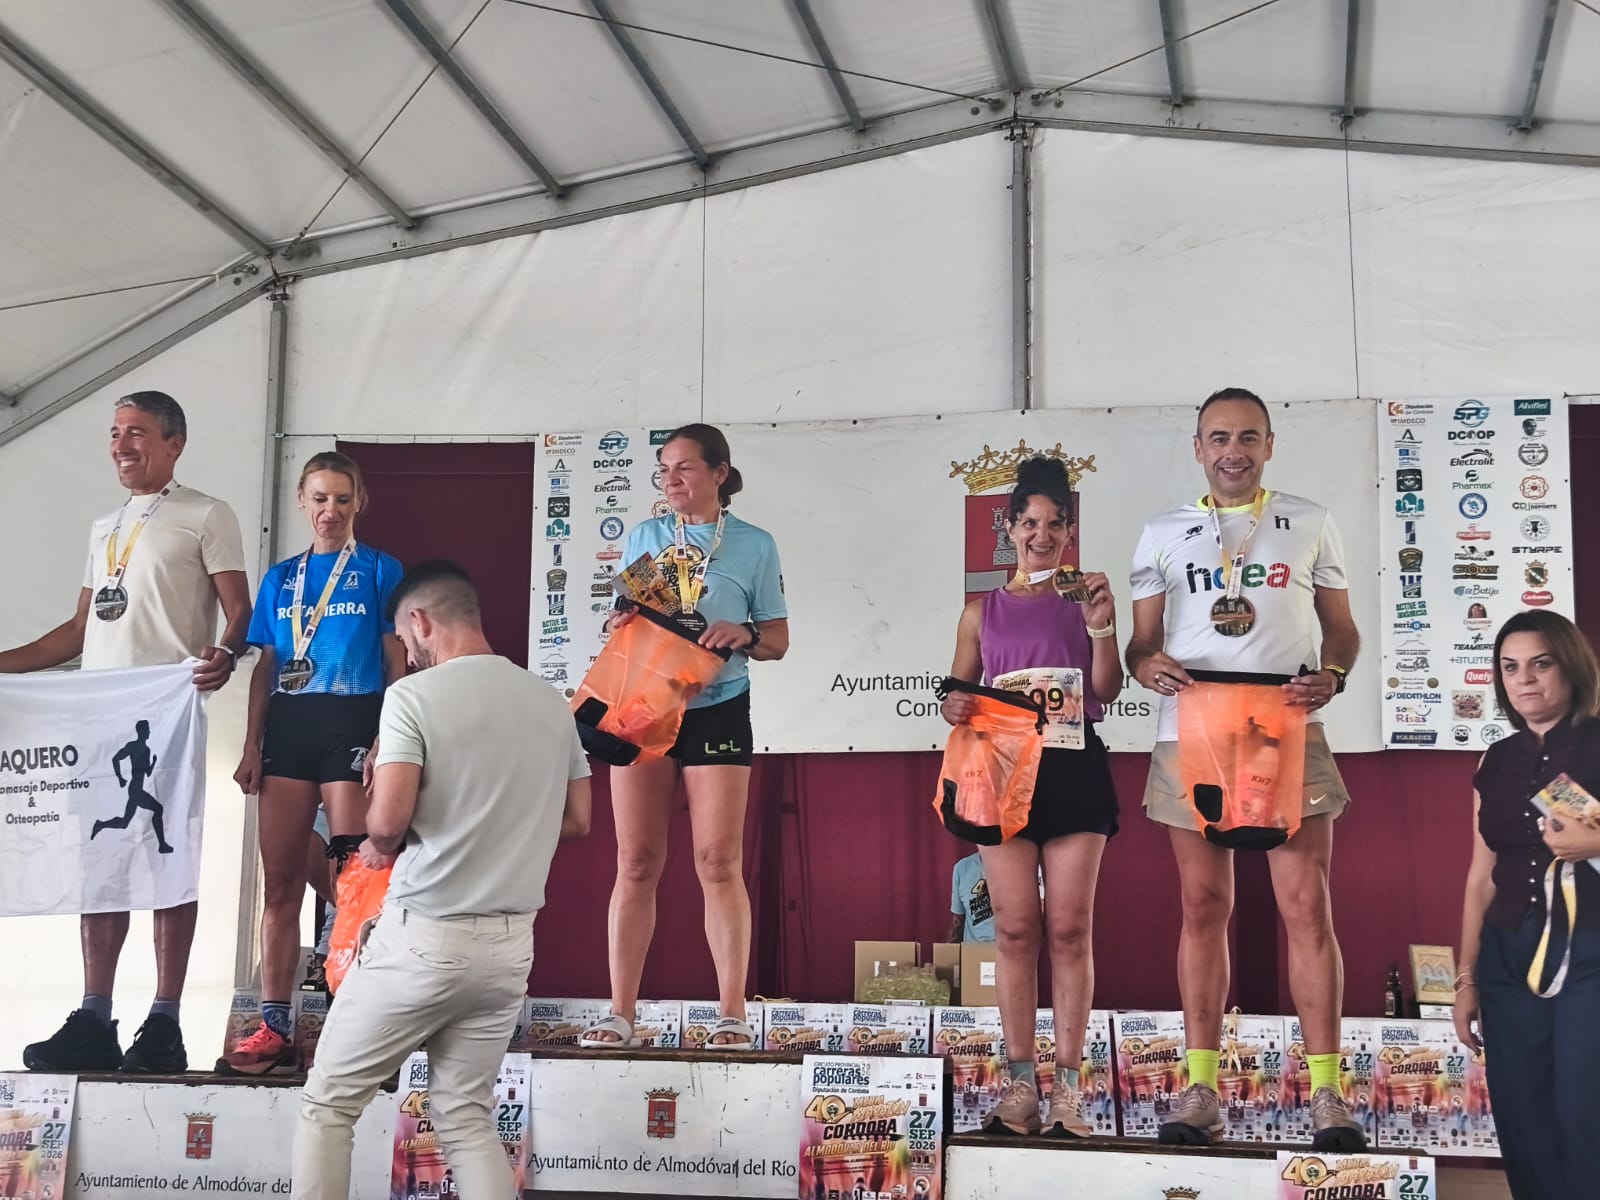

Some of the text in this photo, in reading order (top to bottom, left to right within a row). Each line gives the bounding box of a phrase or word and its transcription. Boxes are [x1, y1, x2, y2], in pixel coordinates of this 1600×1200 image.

[1450, 457, 1494, 467] Electrolit
[594, 483, 632, 493] Electrolit
[831, 671, 950, 697] Ayuntamie
[1102, 697, 1150, 717] ortes
[0, 744, 79, 775] AQUERO
[0, 778, 90, 796] omasaje Deportivo
[6, 811, 60, 826] Osteopatía
[661, 1033, 676, 1044] 27
[828, 1034, 843, 1046] 27
[909, 1038, 925, 1049] 27
[1091, 1042, 1107, 1052] 27
[1263, 1051, 1280, 1062] 27
[1354, 1053, 1372, 1064] 27
[1447, 1055, 1464, 1067] 27
[814, 1066, 861, 1077] carreras
[813, 1073, 869, 1086] populares
[498, 1104, 523, 1121] 27
[909, 1111, 936, 1128] 27
[43, 1123, 66, 1139] 27
[497, 1122, 522, 1132] SEP
[499, 1133, 521, 1142] 2026
[909, 1129, 936, 1140] SEP
[42, 1140, 64, 1149] SEP
[909, 1141, 935, 1150] 2026
[41, 1150, 63, 1158] 2026
[527, 1153, 628, 1175] Ayuntamiento
[633, 1154, 651, 1172] de
[656, 1156, 739, 1176] Almodóvar
[743, 1158, 765, 1176] del
[772, 1160, 796, 1177] Río
[75, 1171, 292, 1195] Ayuntamiento de Almodóvar del
[1400, 1175, 1429, 1194] 27
